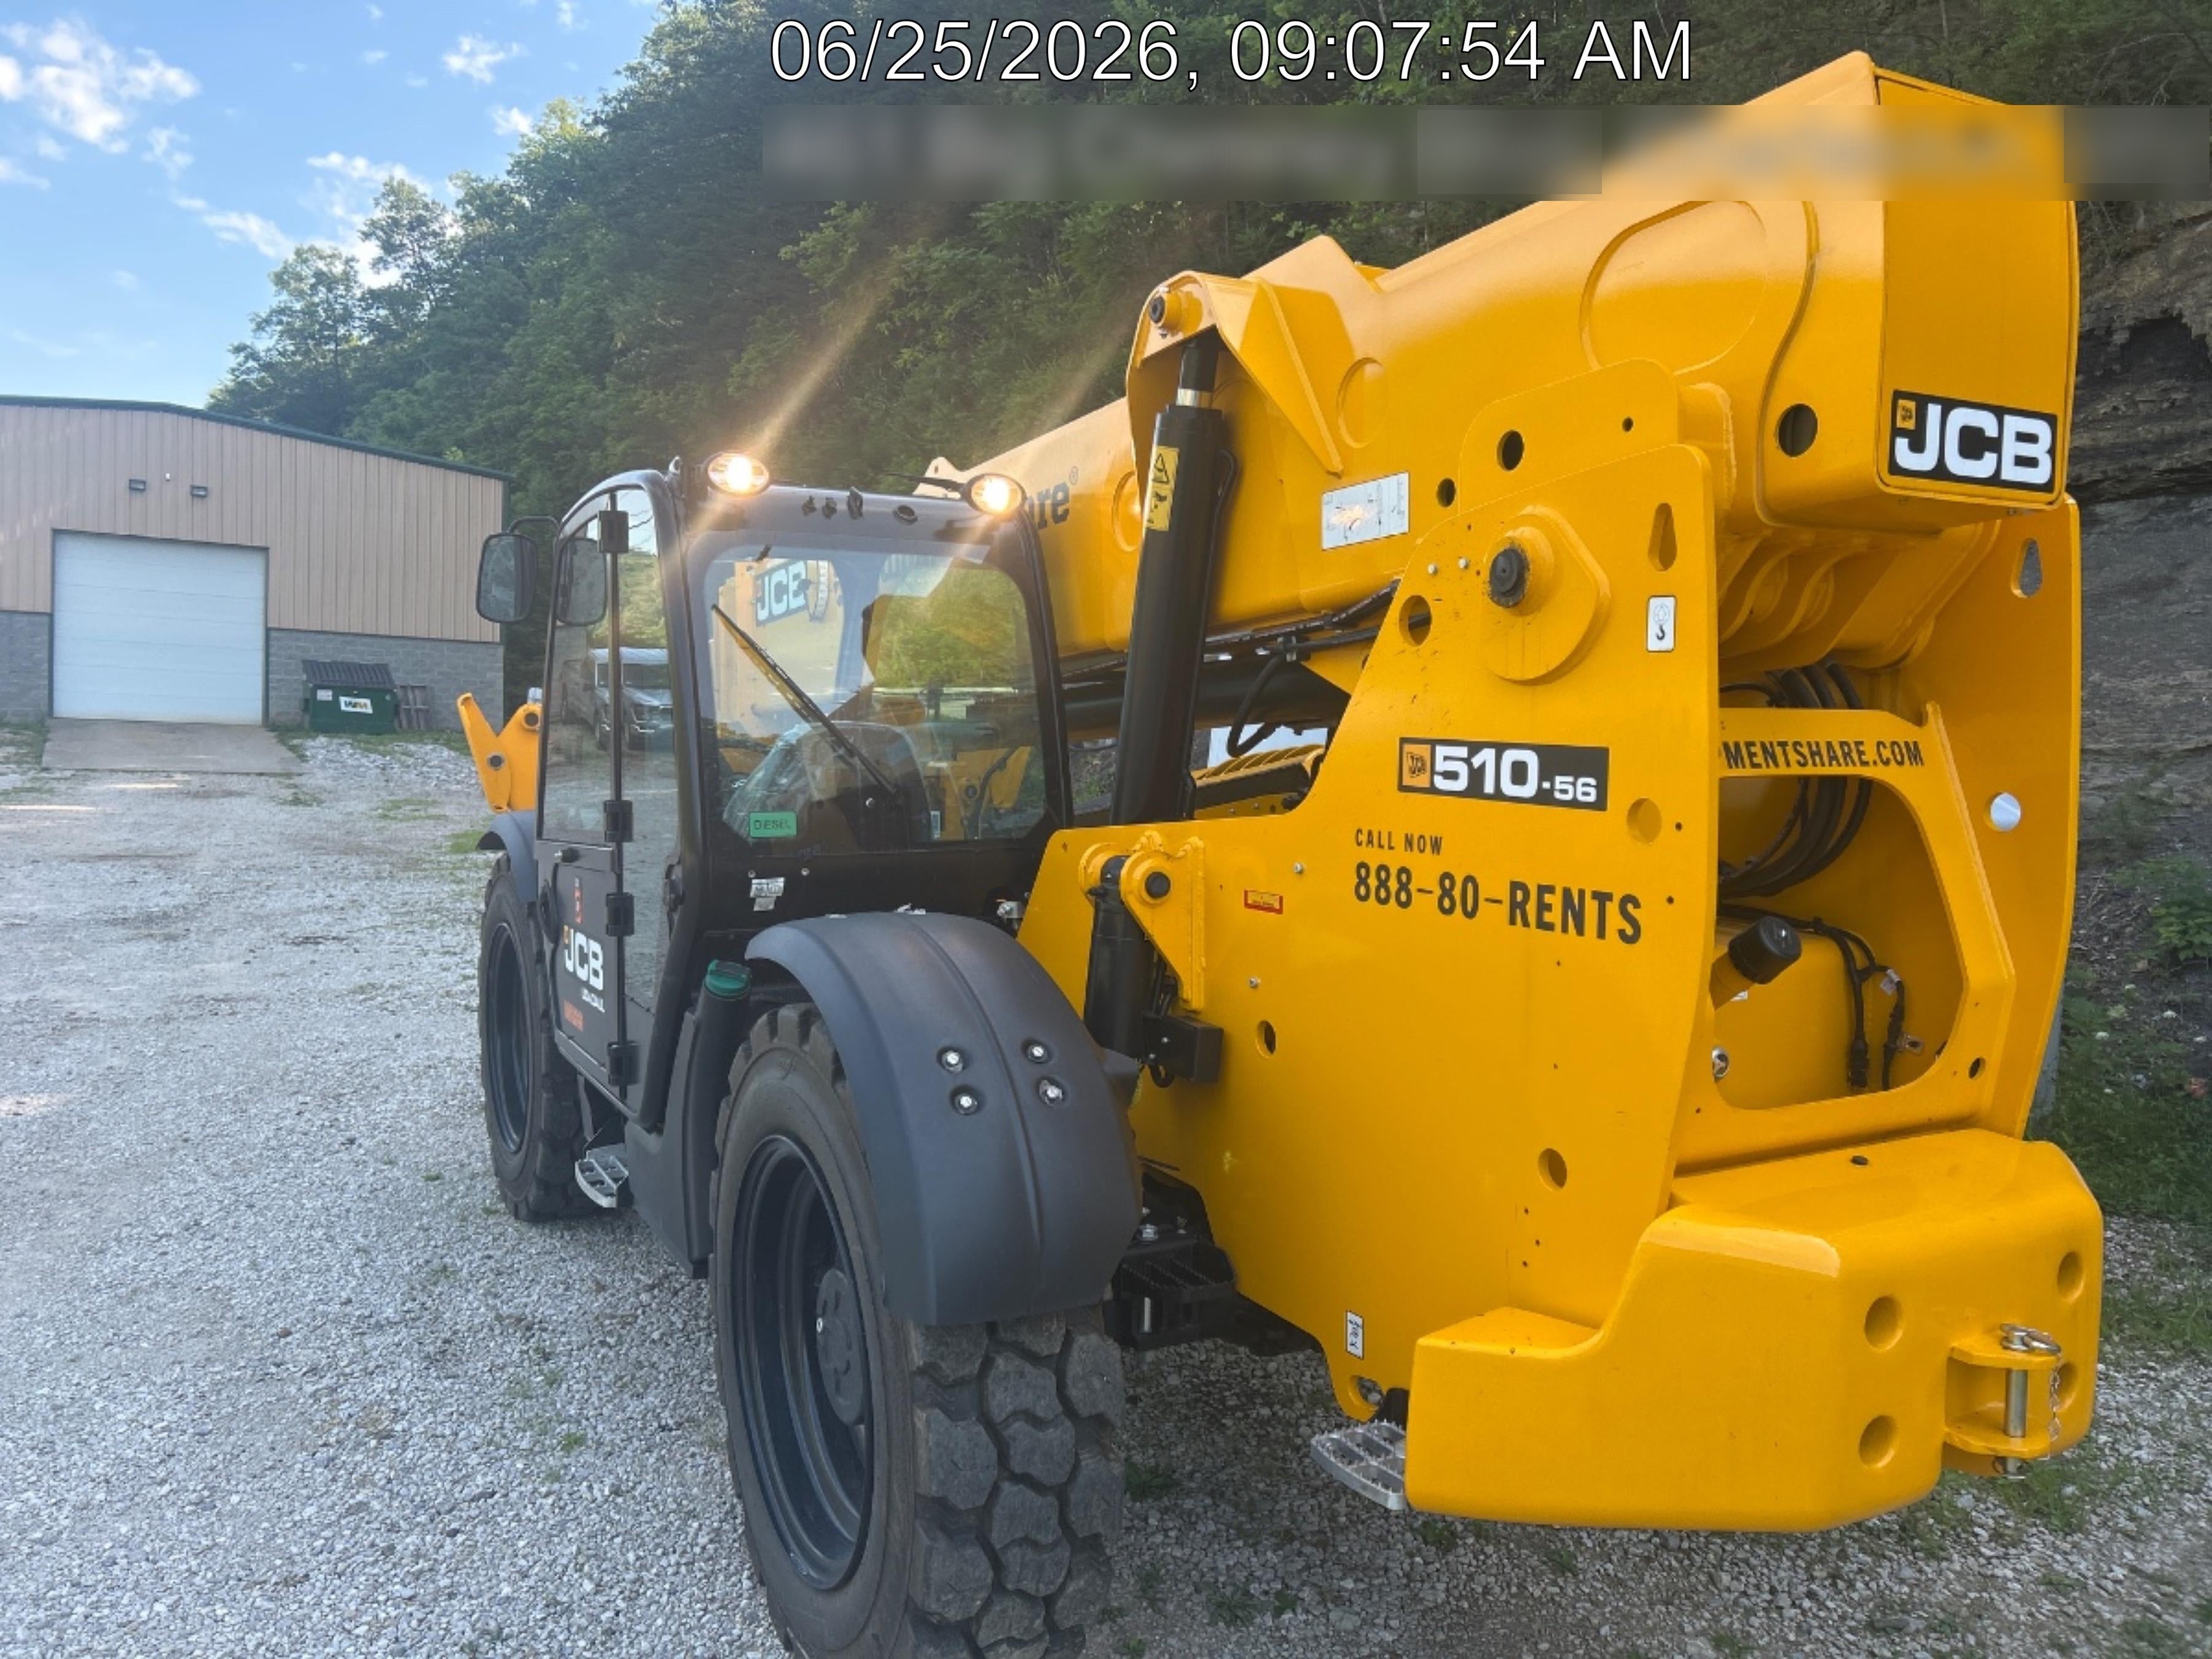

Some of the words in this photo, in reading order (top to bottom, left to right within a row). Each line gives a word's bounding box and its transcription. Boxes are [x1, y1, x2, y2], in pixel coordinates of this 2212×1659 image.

[1894, 402, 2053, 485] JCB
[1718, 740, 1926, 769] MENTSHARE.COM
[1355, 828, 1395, 851] CALL
[1403, 832, 1443, 856] NOW
[1354, 861, 1642, 945] 888-80-RENTS
[565, 927, 603, 991] JCB
